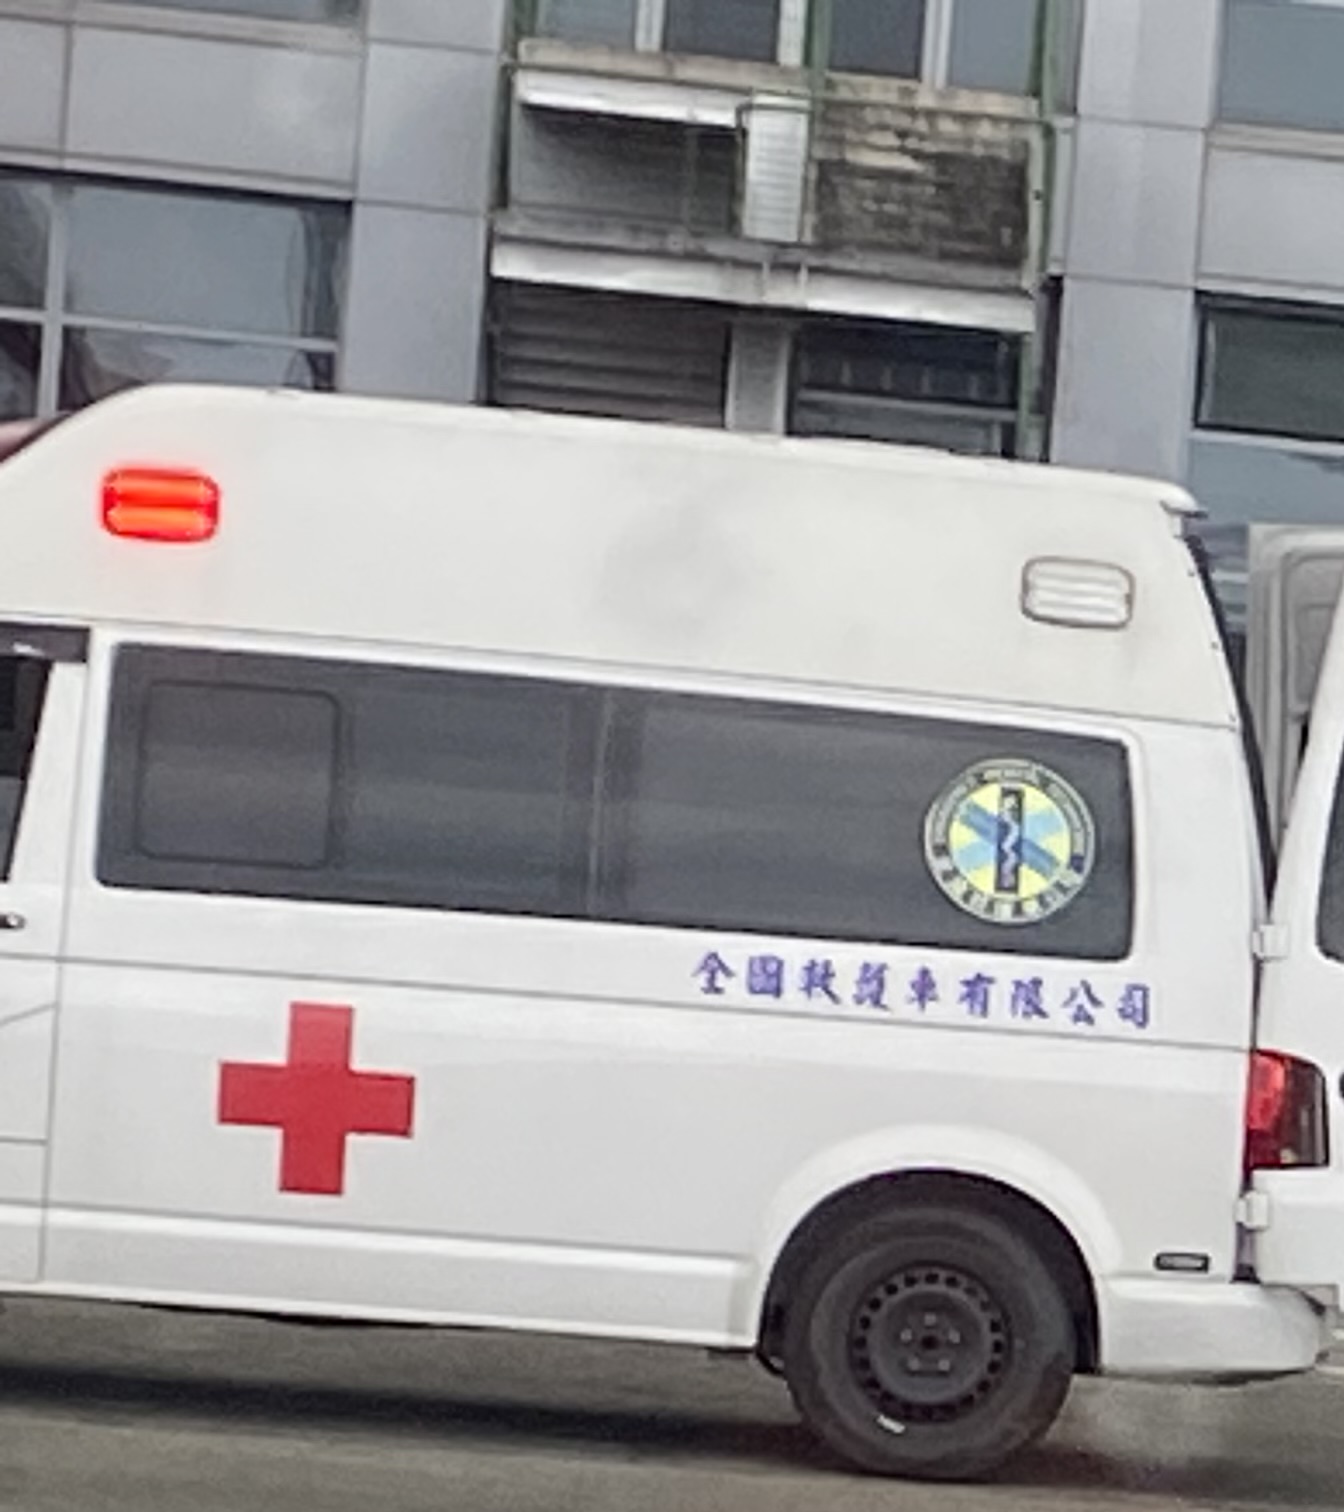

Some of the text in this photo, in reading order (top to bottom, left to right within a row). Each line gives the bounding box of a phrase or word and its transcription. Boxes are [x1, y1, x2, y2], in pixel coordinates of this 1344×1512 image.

[692, 951, 1150, 1028] 全國救護車有限公司
